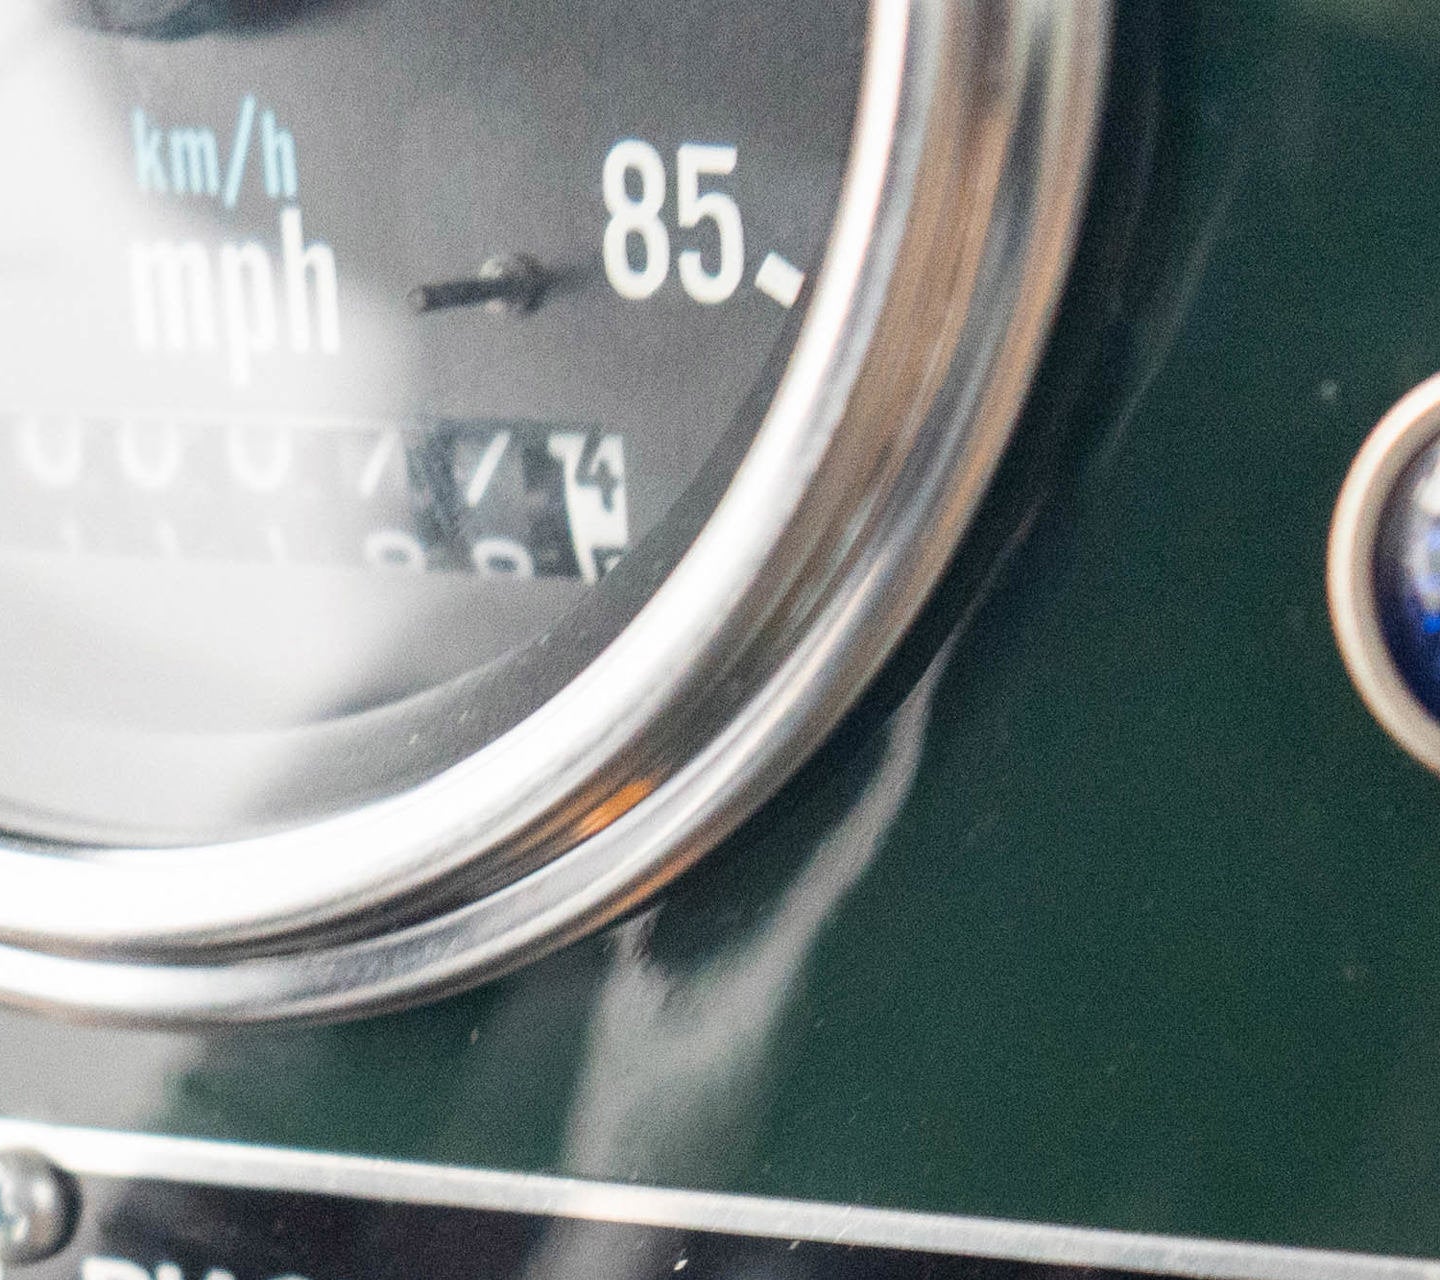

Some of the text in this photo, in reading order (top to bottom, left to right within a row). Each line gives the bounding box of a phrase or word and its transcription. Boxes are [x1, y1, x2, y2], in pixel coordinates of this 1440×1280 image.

[132, 95, 298, 207] km/h
[601, 139, 744, 303] 85
[128, 208, 341, 384] mph
